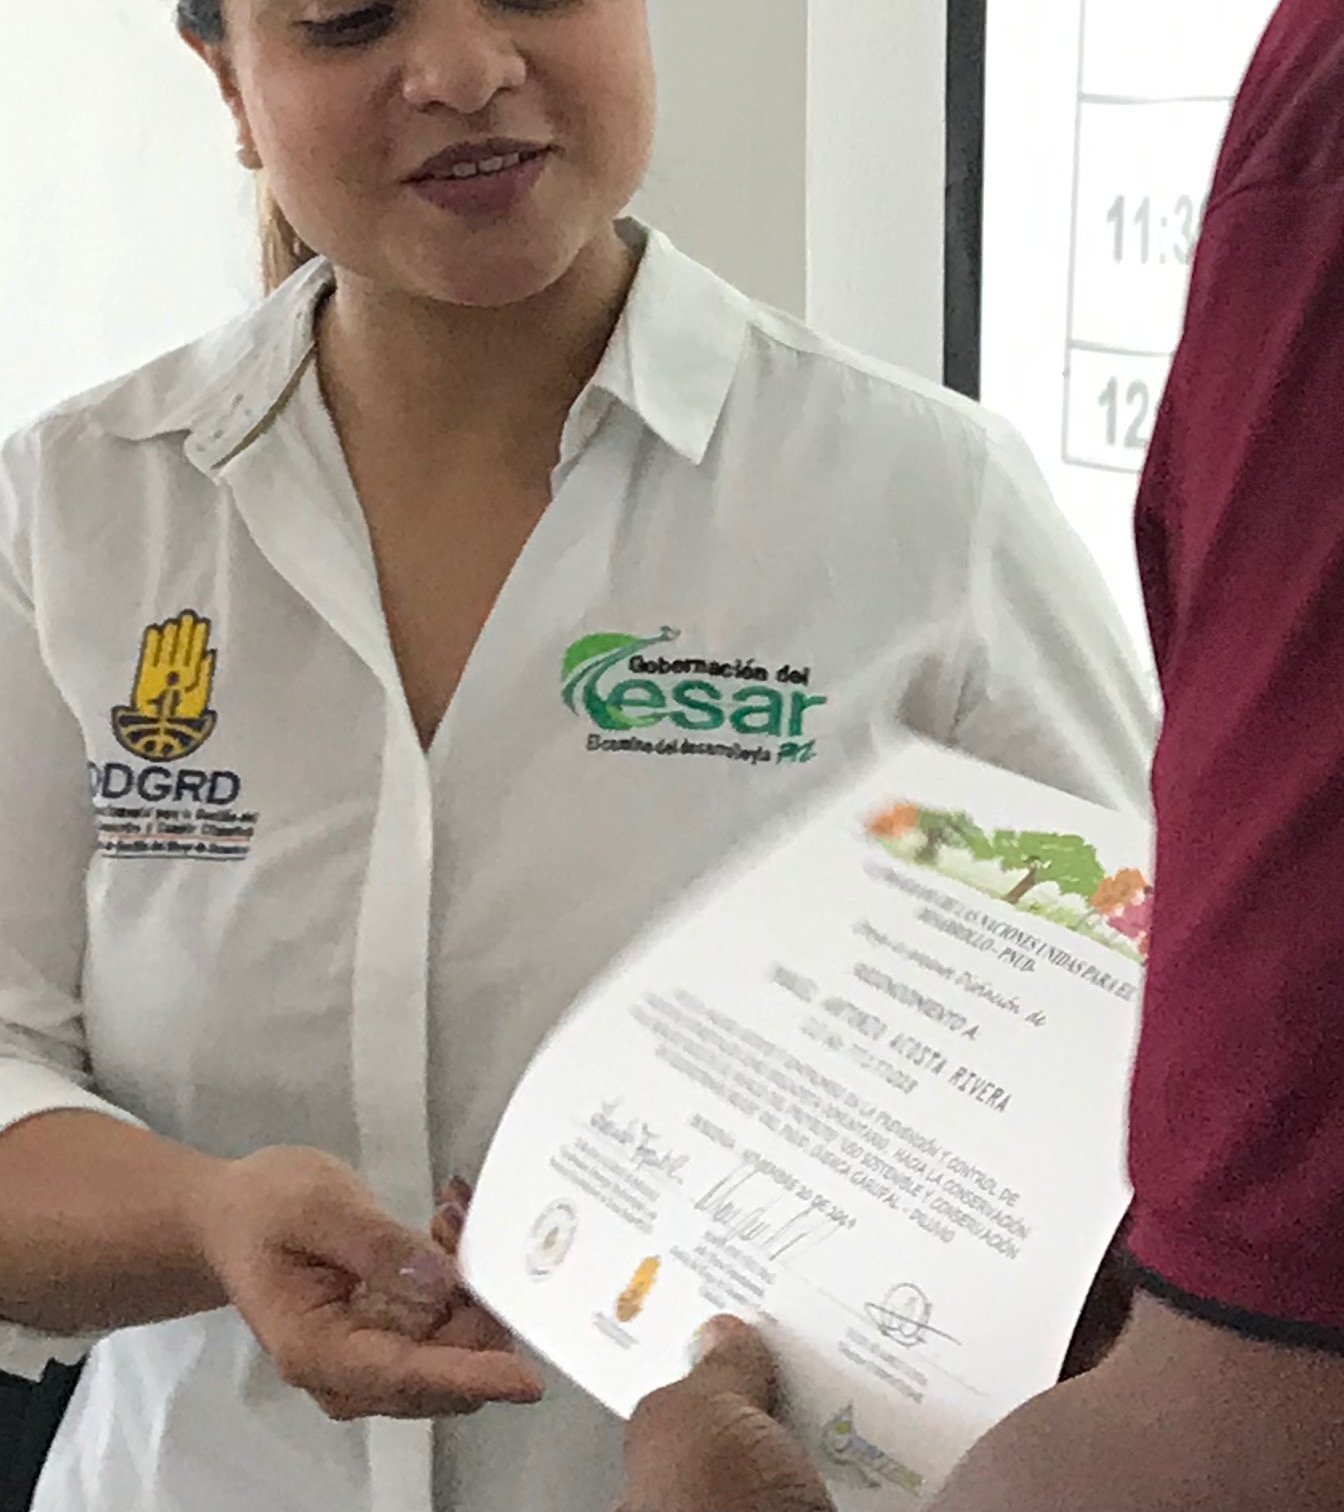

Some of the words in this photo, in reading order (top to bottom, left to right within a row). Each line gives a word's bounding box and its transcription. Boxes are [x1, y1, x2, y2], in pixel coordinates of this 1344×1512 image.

[628, 654, 770, 681] Gobernación
[776, 664, 811, 686] del
[947, 1066, 1012, 1113] RIVERA
